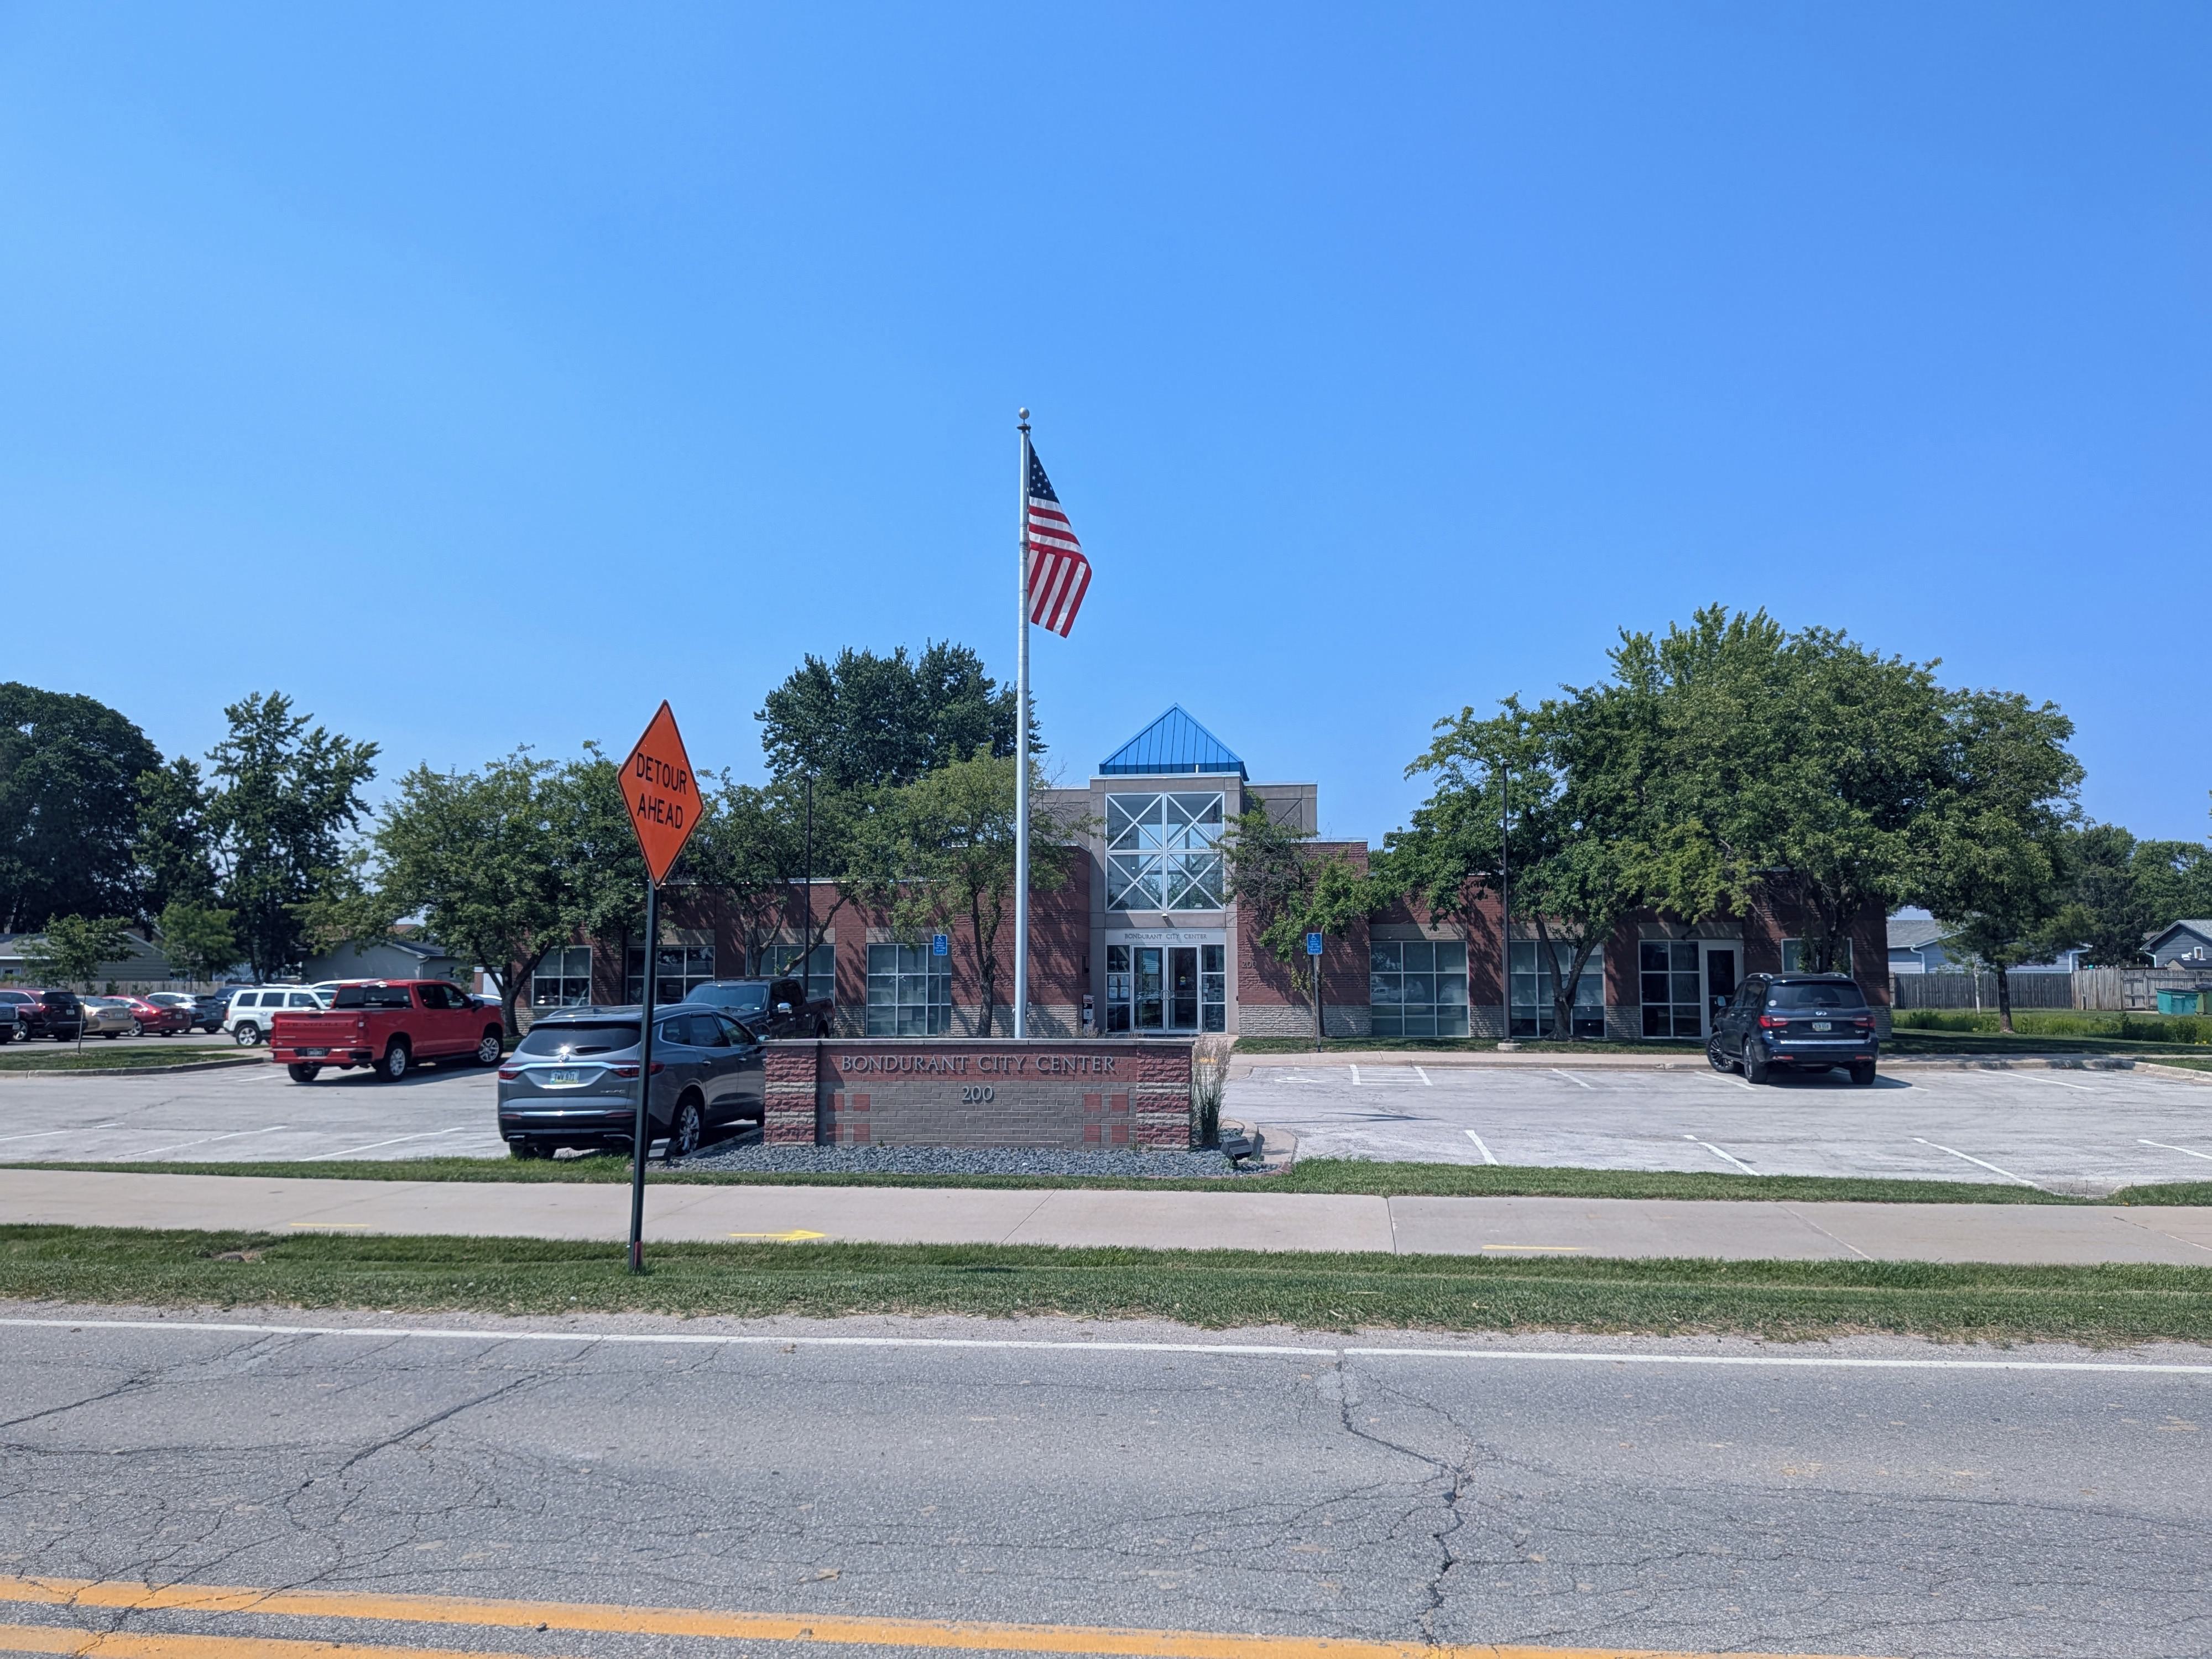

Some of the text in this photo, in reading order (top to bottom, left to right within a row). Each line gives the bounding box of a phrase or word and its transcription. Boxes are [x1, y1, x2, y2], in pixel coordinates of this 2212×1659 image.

[636, 752, 687, 795] DETOUR
[637, 792, 684, 829] AHEAD
[1241, 960, 1256, 968] 200
[841, 1055, 1115, 1072] BONDURANT CITY CENTER
[962, 1086, 993, 1101] 200
